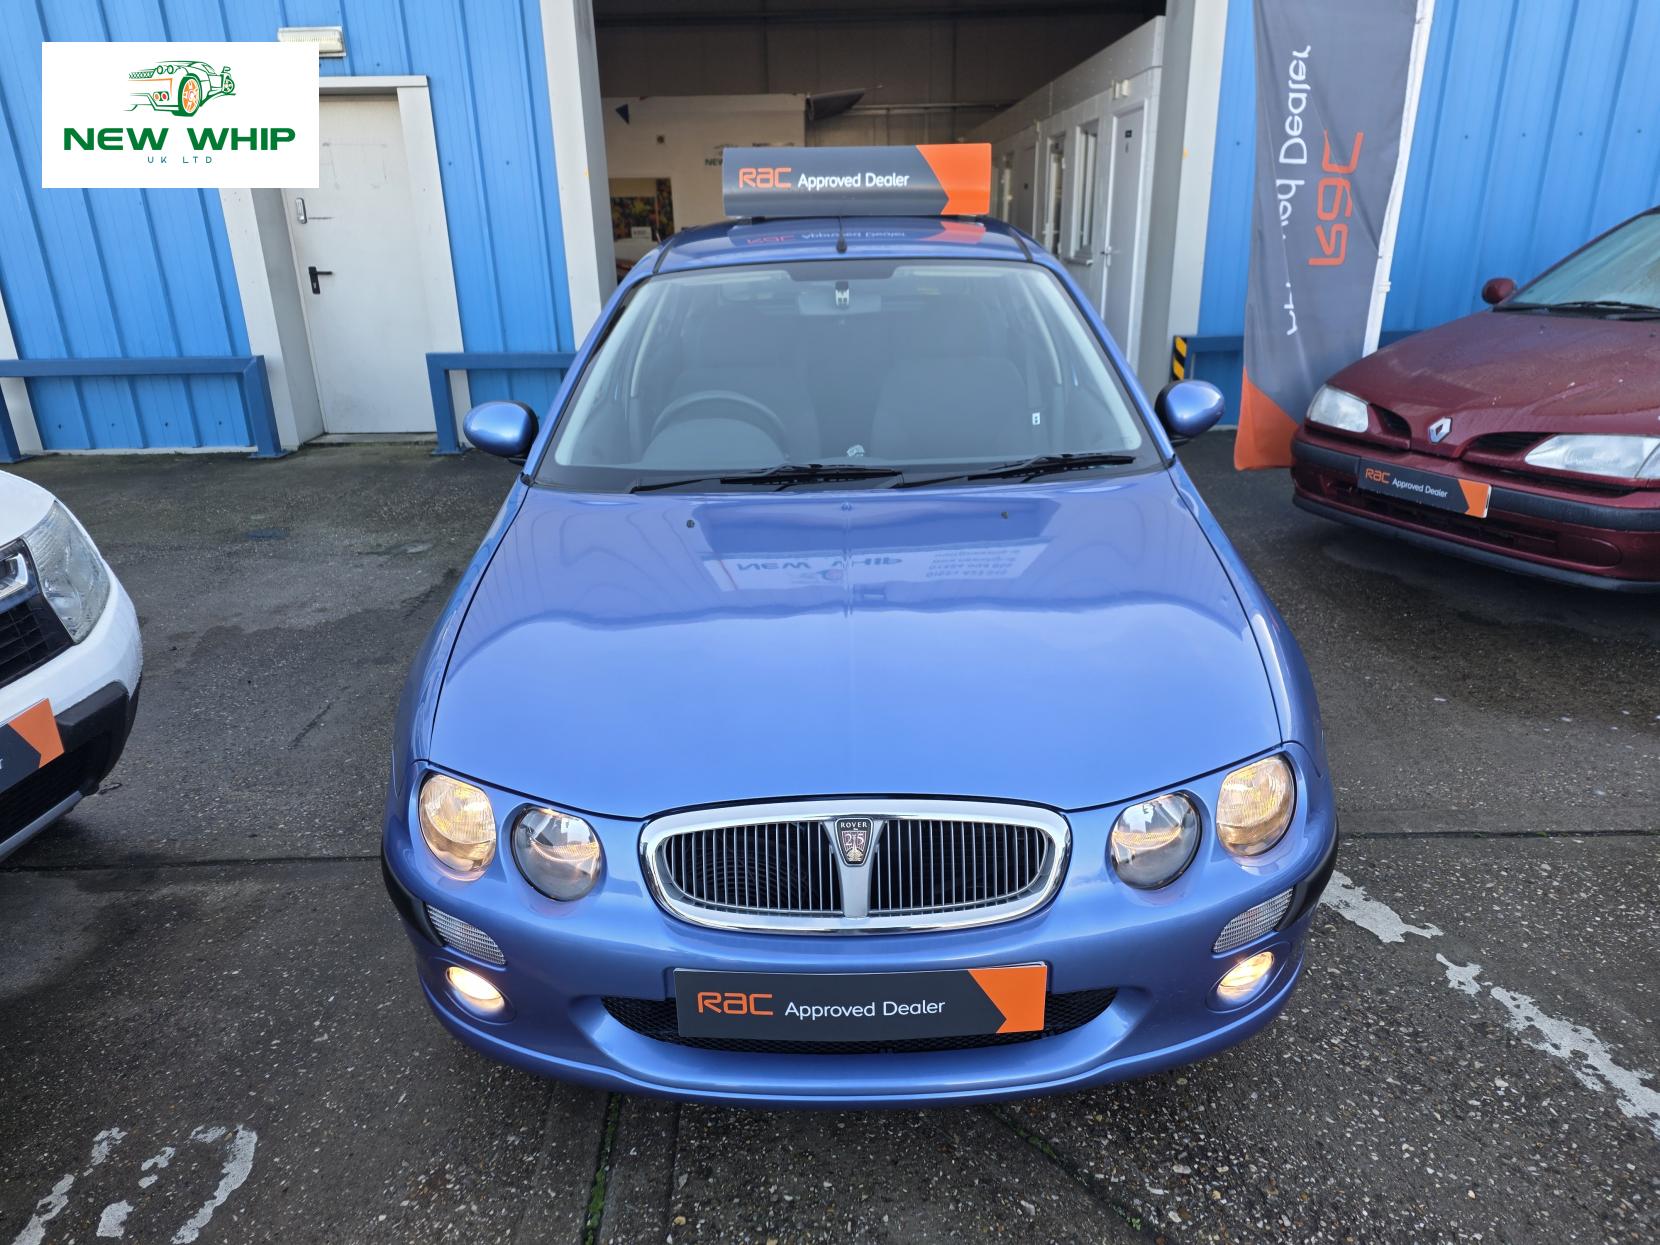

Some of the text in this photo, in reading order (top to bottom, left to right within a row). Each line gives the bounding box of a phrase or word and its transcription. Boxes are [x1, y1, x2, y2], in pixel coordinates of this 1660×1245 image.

[797, 173, 861, 191] Approved
[865, 172, 909, 187] Dealer
[1392, 478, 1424, 493] Approved
[1425, 485, 1448, 498] Dealer
[844, 833, 865, 846] 25
[784, 1001, 876, 1021] Approved
[883, 1000, 946, 1016] Dealer
